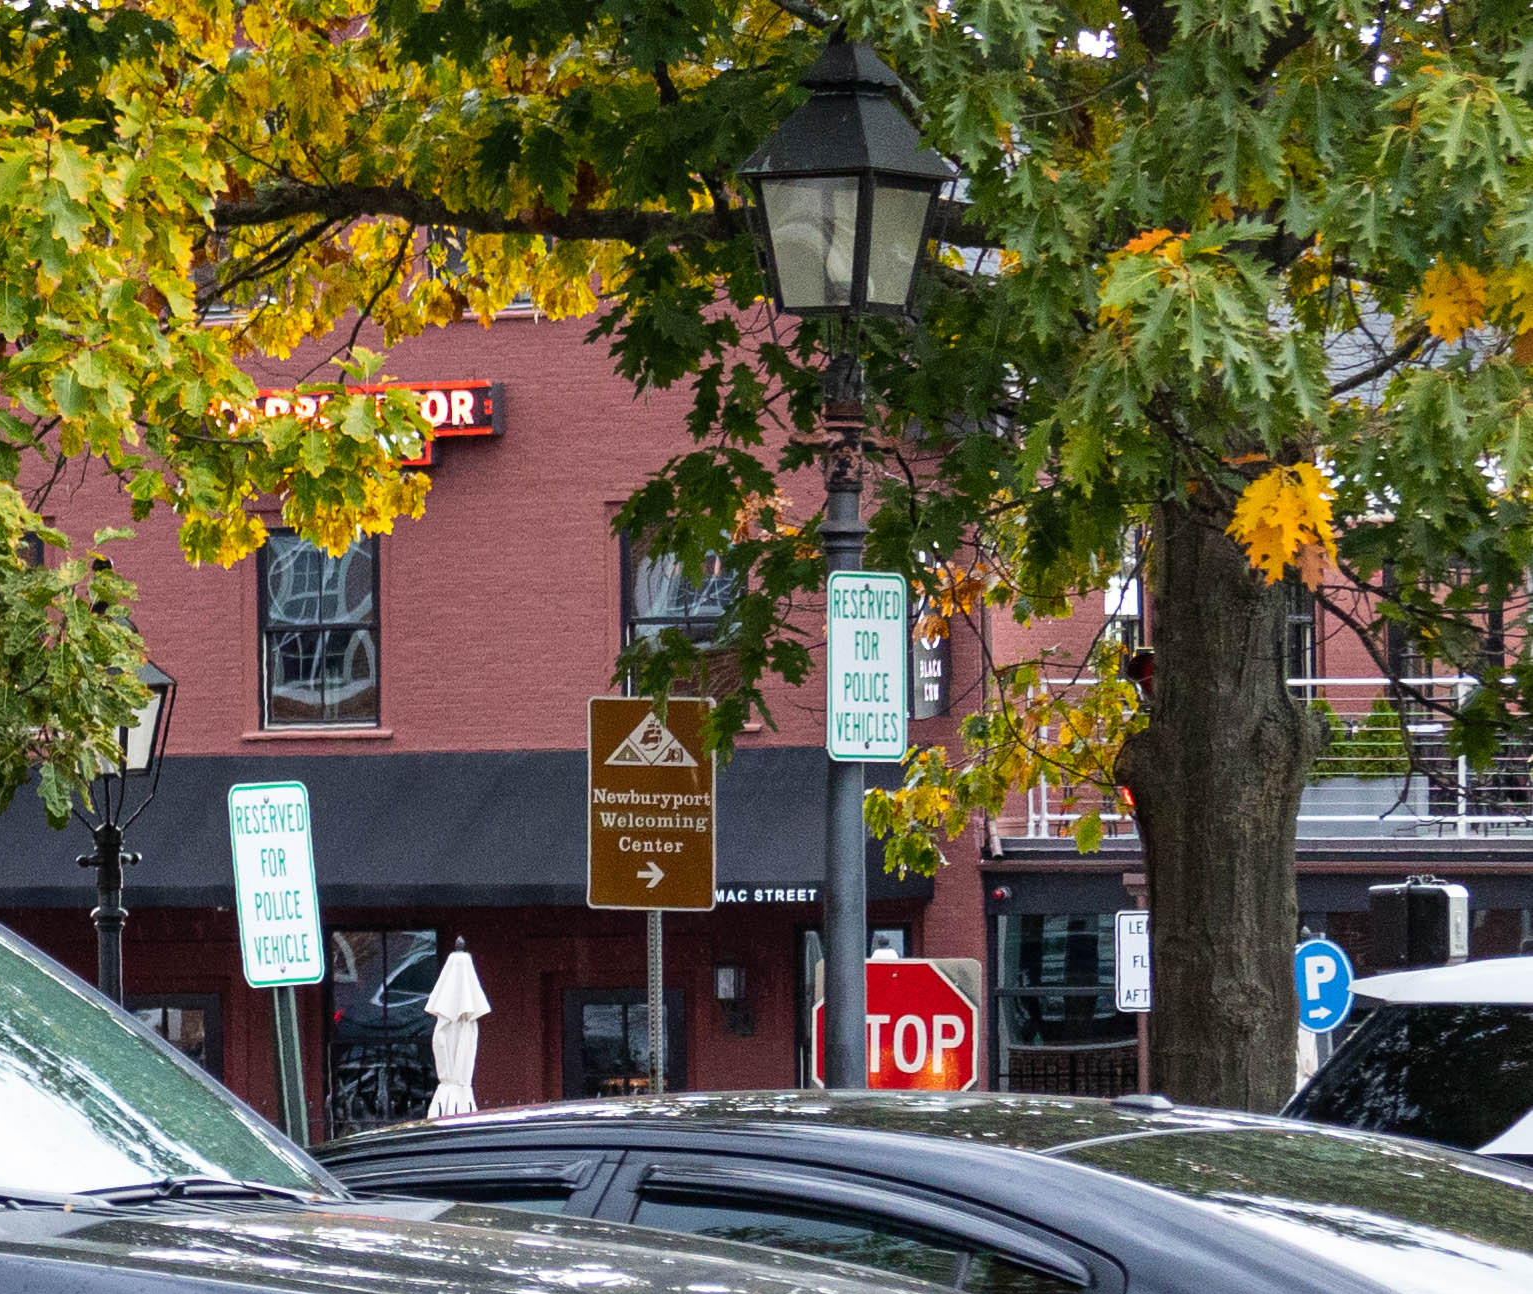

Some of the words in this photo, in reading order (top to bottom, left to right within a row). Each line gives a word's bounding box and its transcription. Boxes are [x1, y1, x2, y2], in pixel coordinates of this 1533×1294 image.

[833, 589, 900, 620] RESERVED
[854, 631, 880, 661] FOR
[843, 672, 890, 703] POLICE
[836, 712, 898, 743] VEHICLES
[593, 789, 711, 809] Newburyport
[235, 803, 305, 835] RESERVED
[600, 813, 709, 832] Welcoming
[619, 837, 684, 853] Center
[260, 848, 287, 877] FOR
[254, 890, 302, 921] POLICE
[754, 889, 817, 902] STREET
[253, 933, 310, 966] VEHICLE
[1304, 955, 1337, 1001] P
[866, 1014, 965, 1074] TOP
